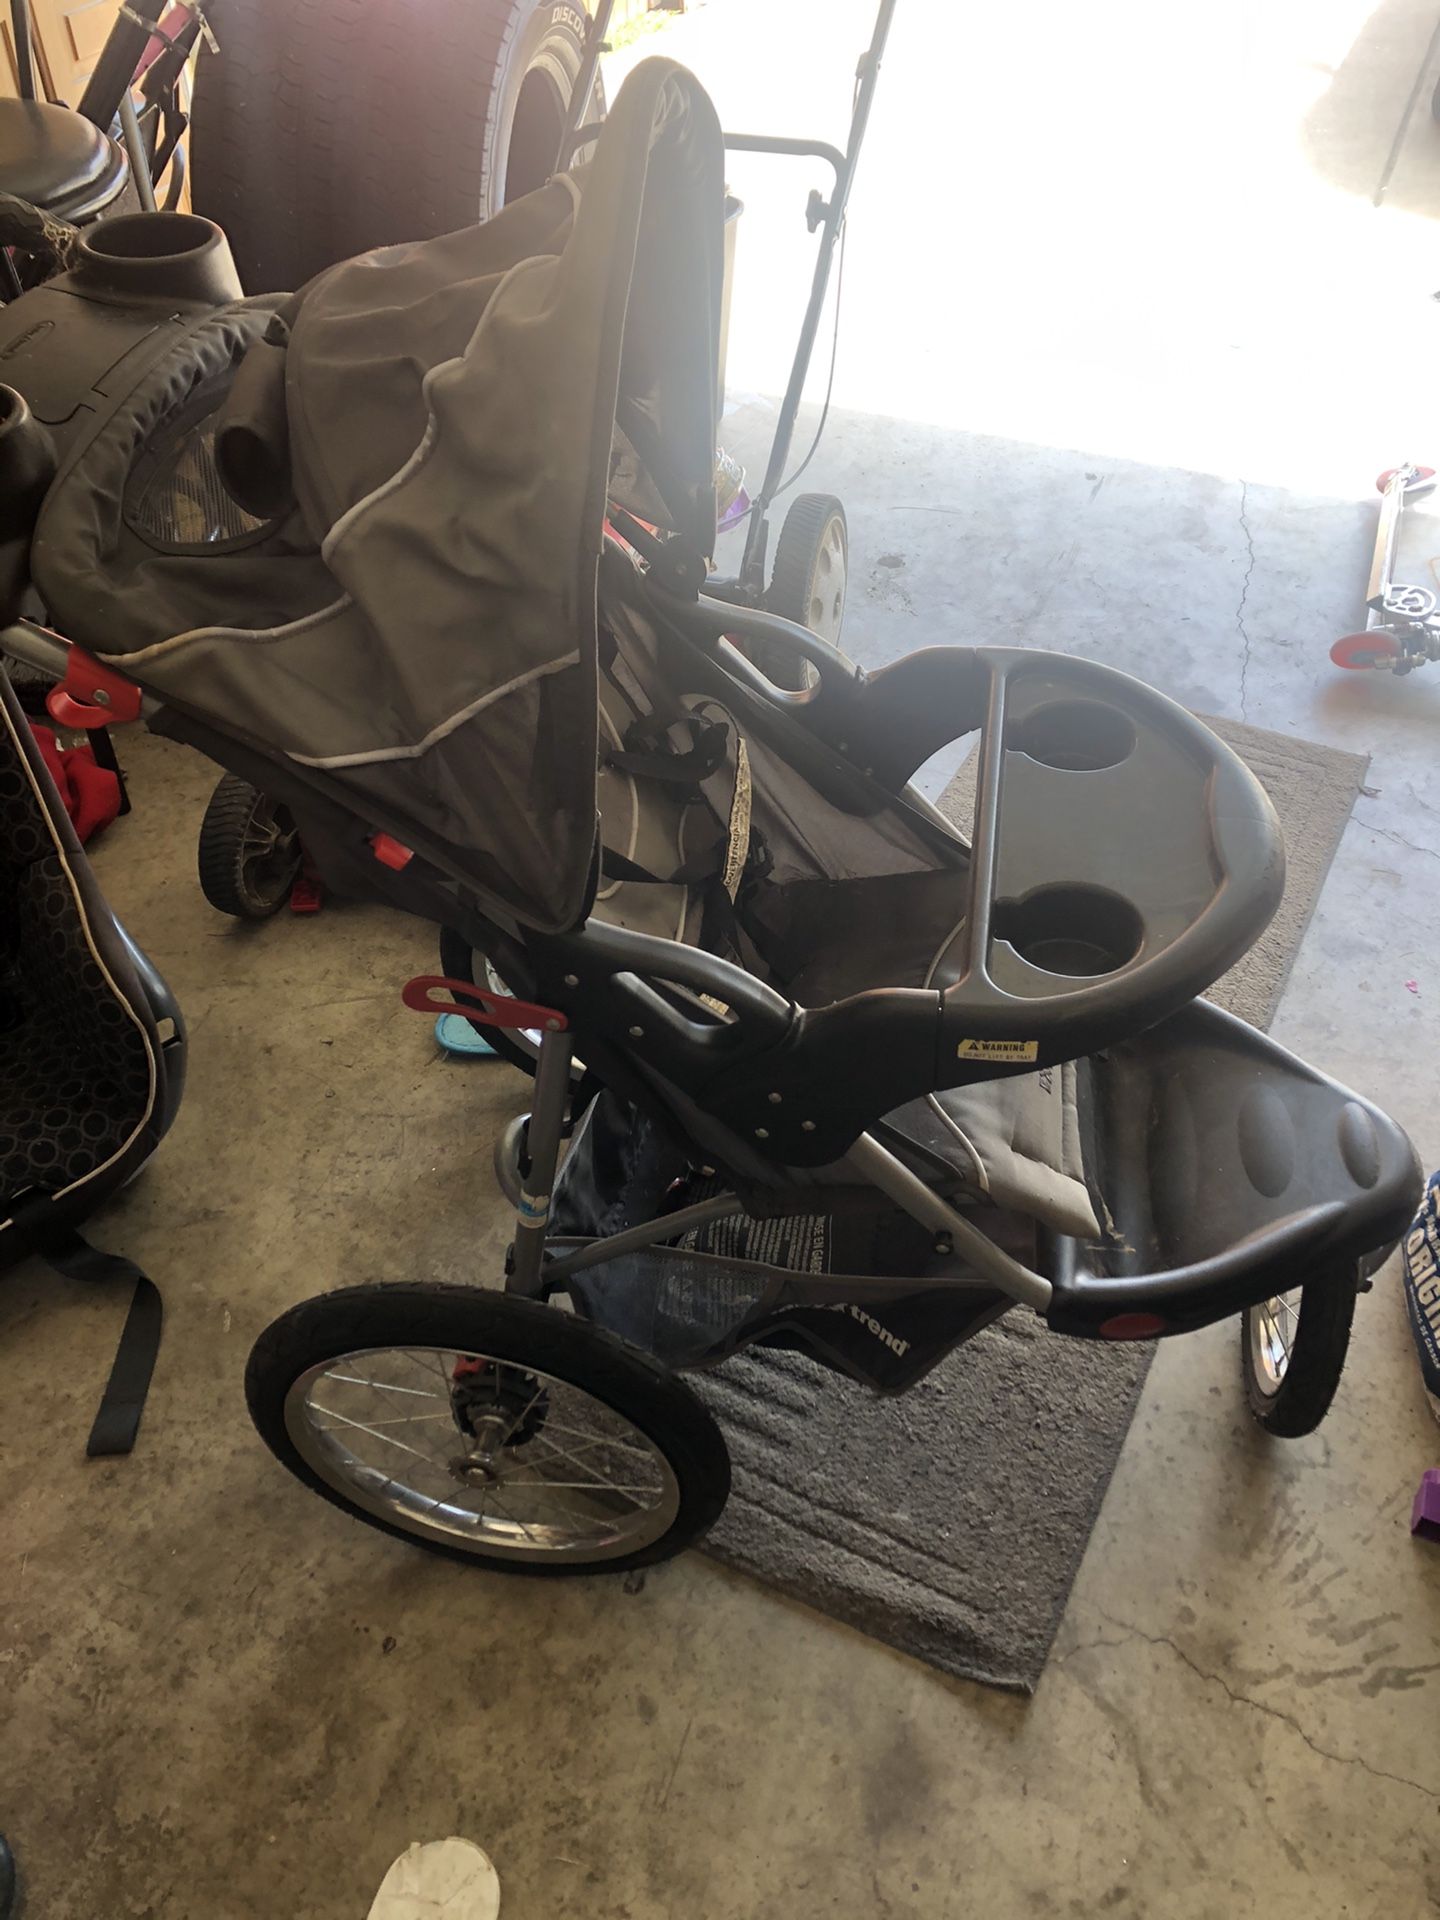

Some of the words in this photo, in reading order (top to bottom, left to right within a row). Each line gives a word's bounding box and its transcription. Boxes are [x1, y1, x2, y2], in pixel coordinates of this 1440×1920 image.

[551, 6, 586, 45] DISCOV
[982, 1042, 1025, 1052] WARNING
[850, 1304, 908, 1357] trend
